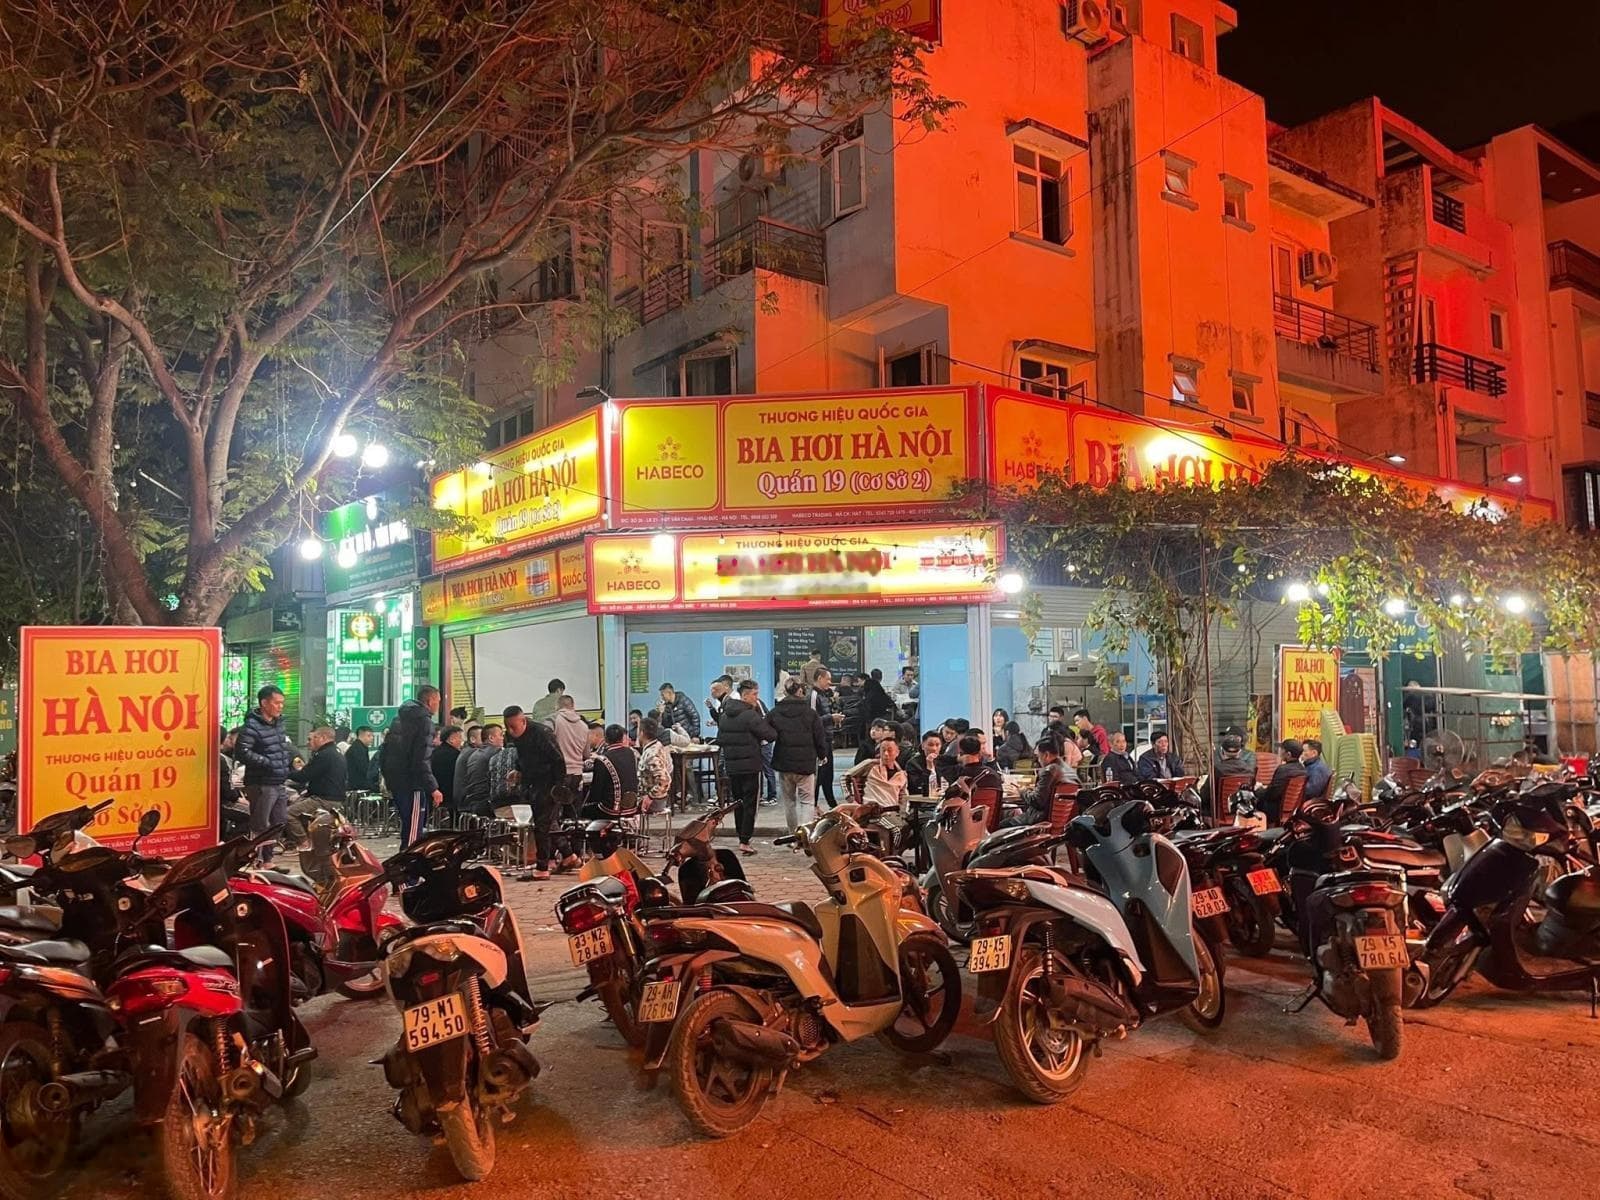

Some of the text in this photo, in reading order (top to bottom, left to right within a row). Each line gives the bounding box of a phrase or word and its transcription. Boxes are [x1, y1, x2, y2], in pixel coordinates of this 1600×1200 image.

[758, 402, 929, 424] THƯƠNG HIỆU QUỐC GIA
[552, 438, 565, 452] GIA
[737, 423, 953, 464] BIA HƠI HÀ NỘI
[636, 465, 704, 480] HABECO
[1004, 459, 1062, 482] HAB
[1086, 438, 1145, 489] BIA
[482, 452, 578, 516] BIA HƠI HÀ NỘI
[758, 467, 931, 499] Quán 19 (Cơ Sở 2)
[736, 534, 869, 549] THƯƠNG HIỆU QUỐC GIA
[451, 583, 466, 599] BIA
[484, 570, 498, 591] HÀ
[500, 567, 518, 591] NỘI
[562, 568, 582, 588] QUỐC
[607, 580, 661, 592] HABECO
[65, 647, 180, 676] BIA HƠI
[1295, 657, 1325, 674] BIA HƠI
[1287, 675, 1333, 708] HÀ NỘI
[42, 686, 112, 737] HÀ
[118, 685, 200, 741] NỘI
[45, 746, 197, 766] THƯƠNG HIỆU QUỐC GIA
[65, 765, 178, 799] Quán 19
[976, 936, 1005, 955] 29-X5
[971, 952, 1006, 971] 394.31
[411, 998, 455, 1027] 79-N1
[408, 1014, 464, 1048] 594.50
